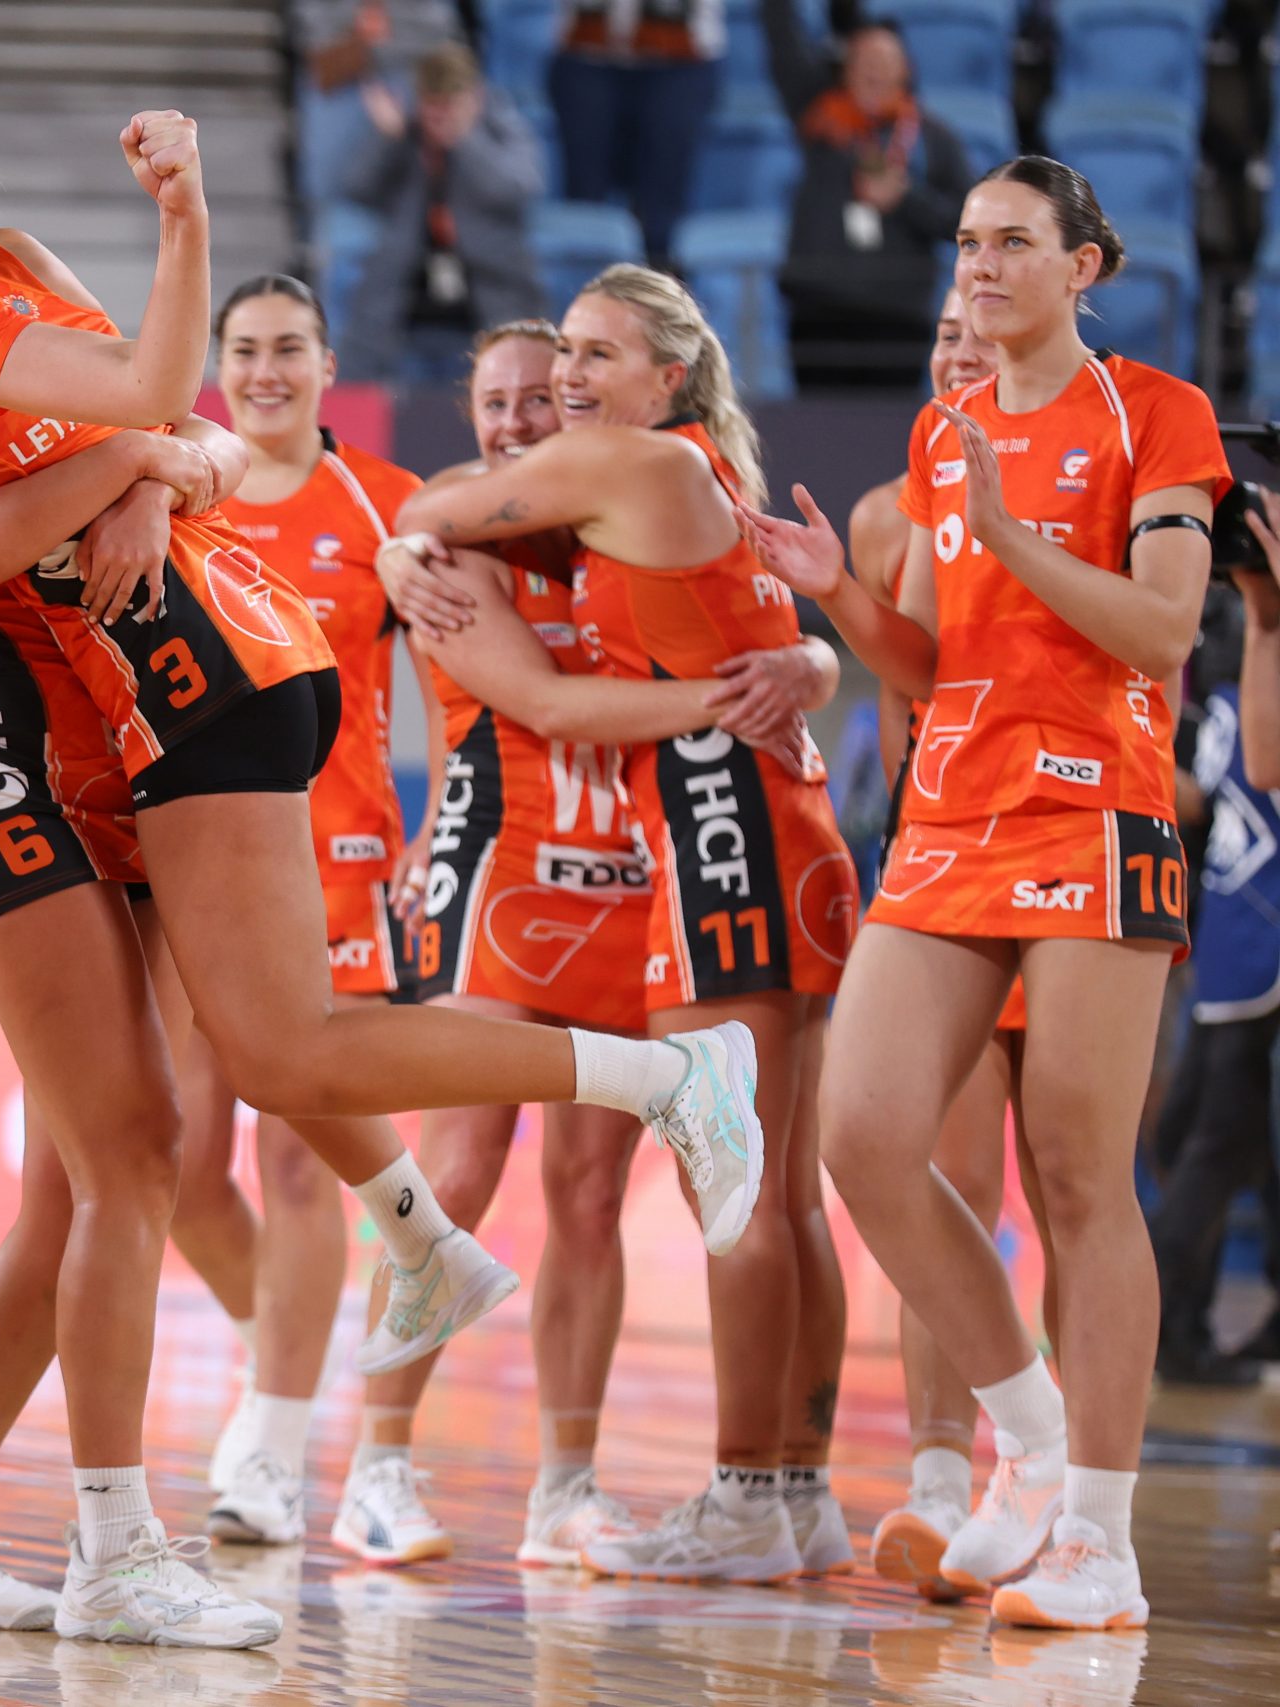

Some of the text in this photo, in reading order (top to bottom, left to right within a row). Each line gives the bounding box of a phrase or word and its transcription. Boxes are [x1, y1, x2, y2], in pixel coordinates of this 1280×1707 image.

[149, 637, 208, 709] 3
[431, 752, 474, 855] HCF
[550, 743, 631, 836] W
[1043, 757, 1094, 780] FDC
[685, 768, 750, 897] HCF
[1126, 853, 1182, 918] 10
[699, 907, 769, 972] 11
